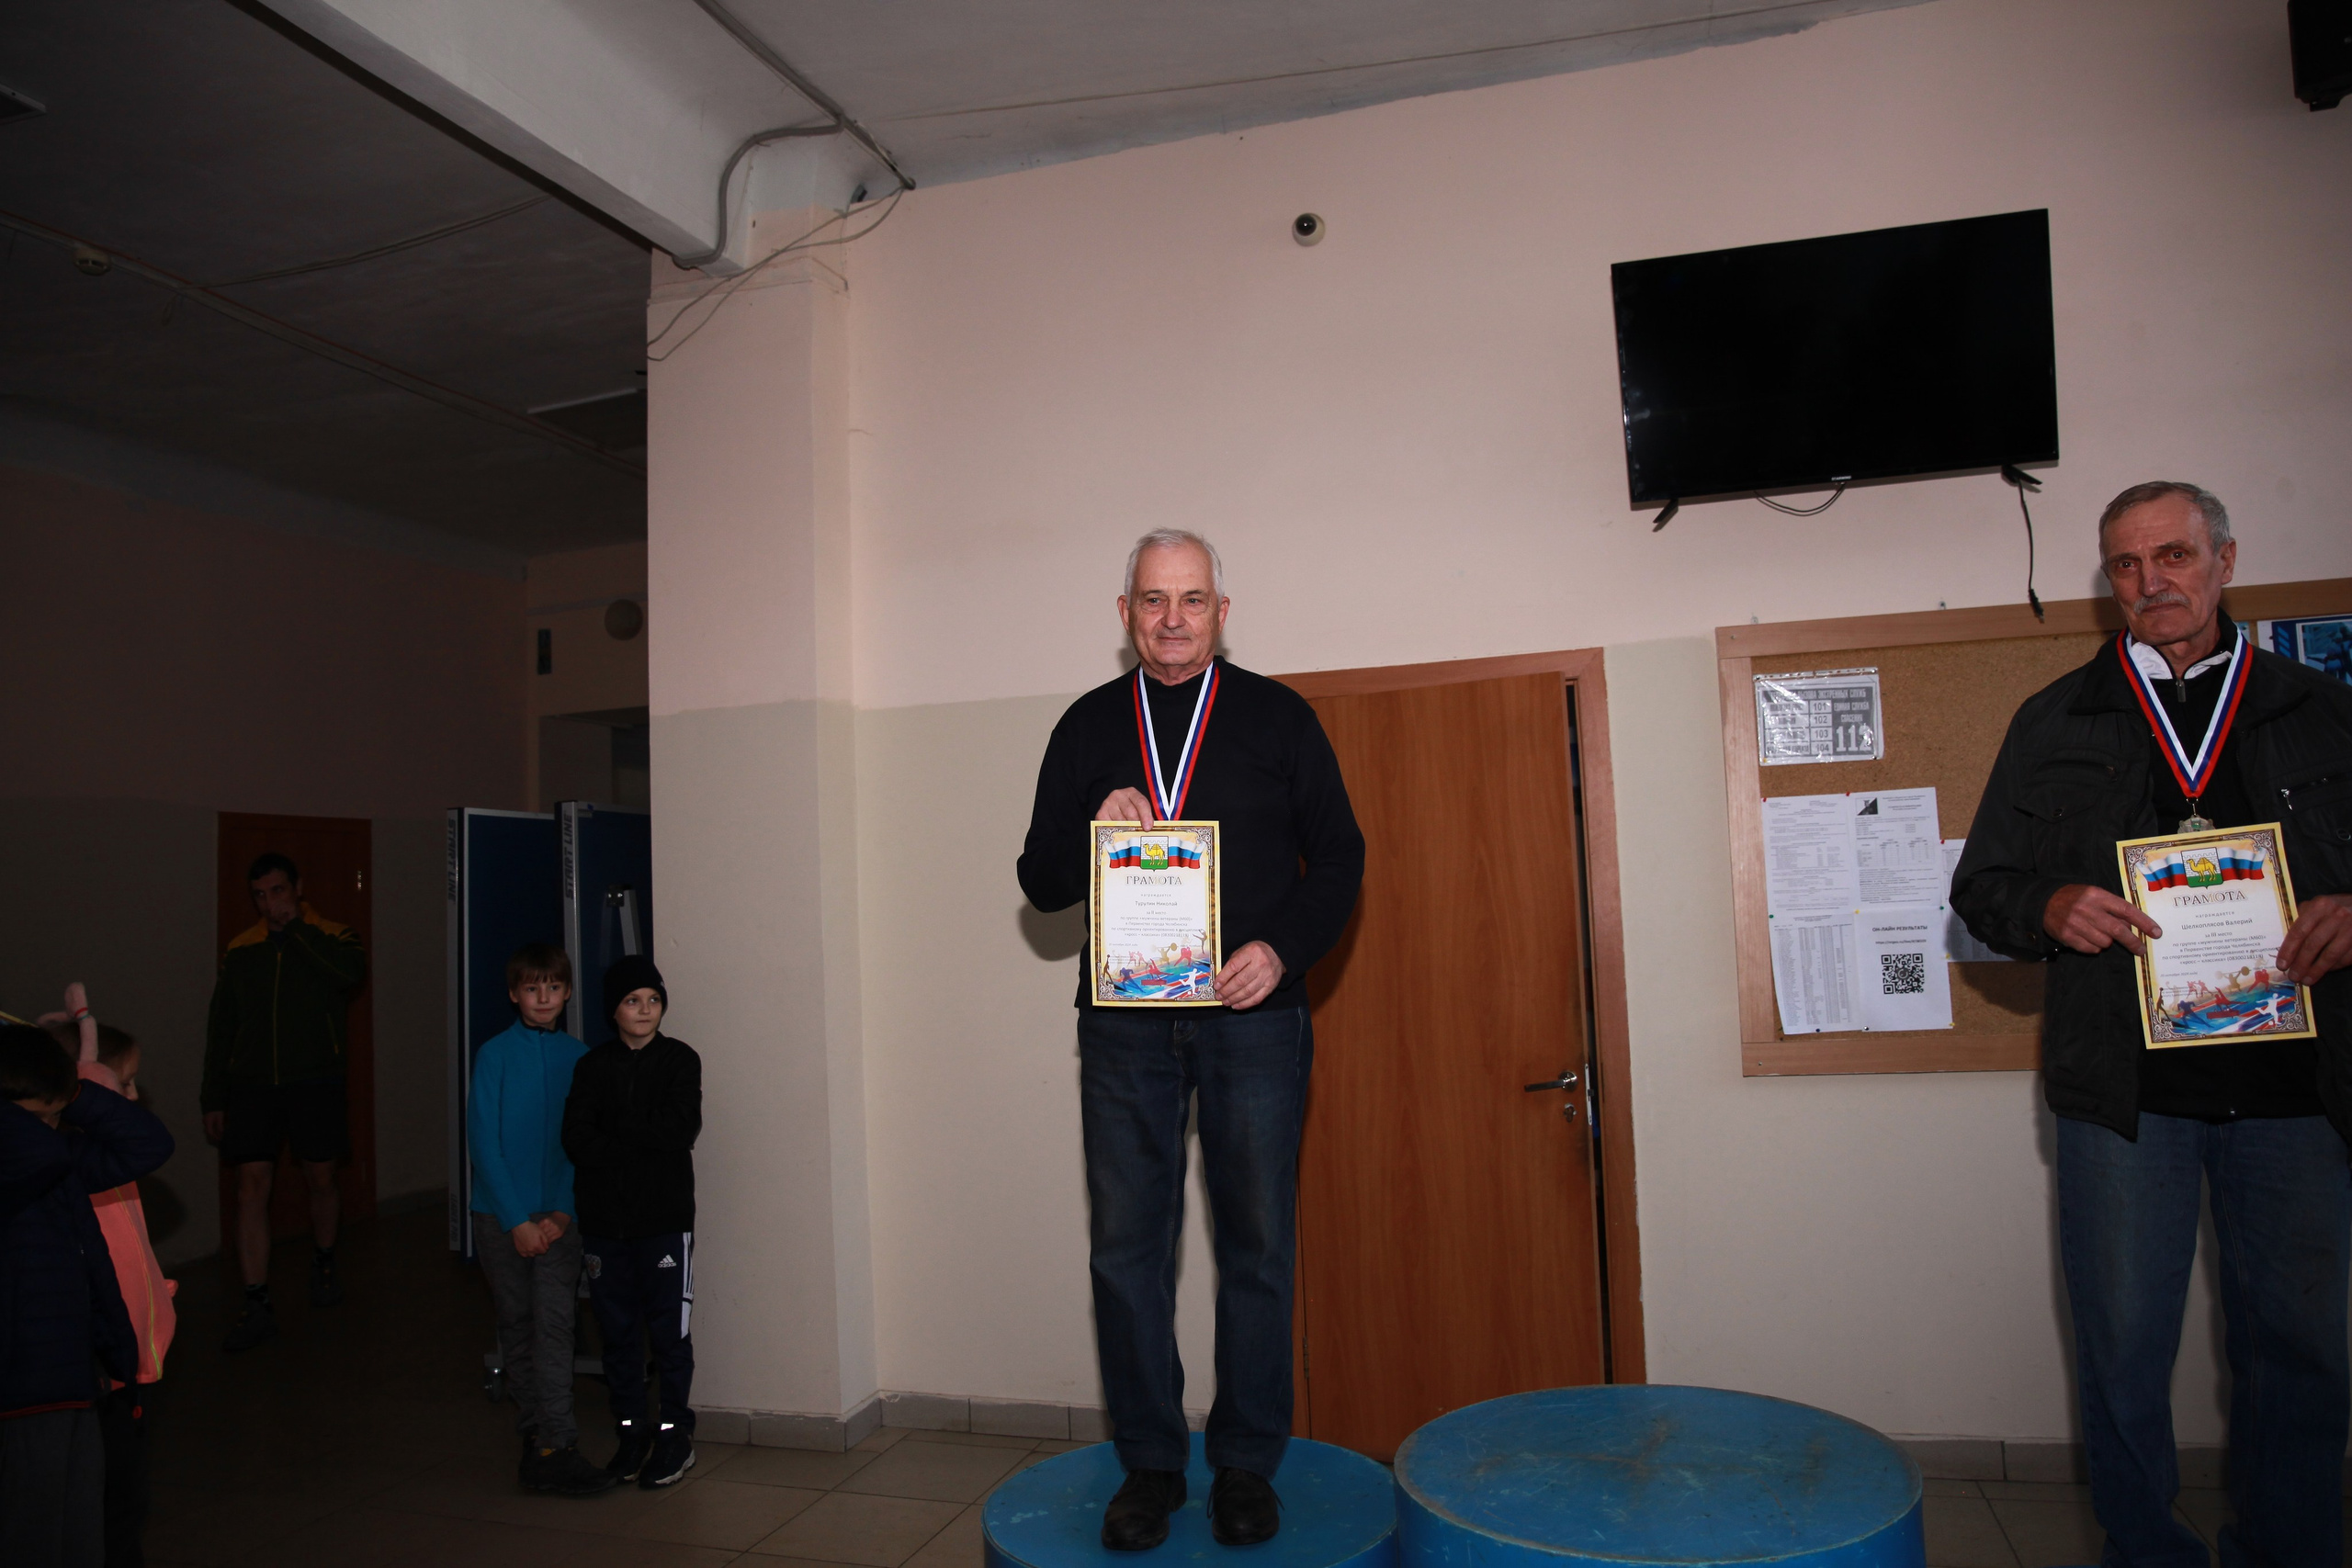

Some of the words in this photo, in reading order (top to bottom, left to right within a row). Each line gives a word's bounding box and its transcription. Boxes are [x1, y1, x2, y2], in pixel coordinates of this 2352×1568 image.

[1813, 703, 1826, 712] 101
[1815, 716, 1828, 724] 102
[1815, 729, 1828, 739] 103
[1836, 724, 1872, 752] 112
[1815, 744, 1829, 752] 104
[563, 810, 573, 845] LINE
[447, 818, 456, 869] START
[564, 847, 574, 900] START
[1125, 875, 1183, 886] ГРАМОТА
[447, 871, 457, 904] LINE
[2173, 890, 2246, 907] ГРАМОТА
[2225, 918, 2253, 927] Валерий
